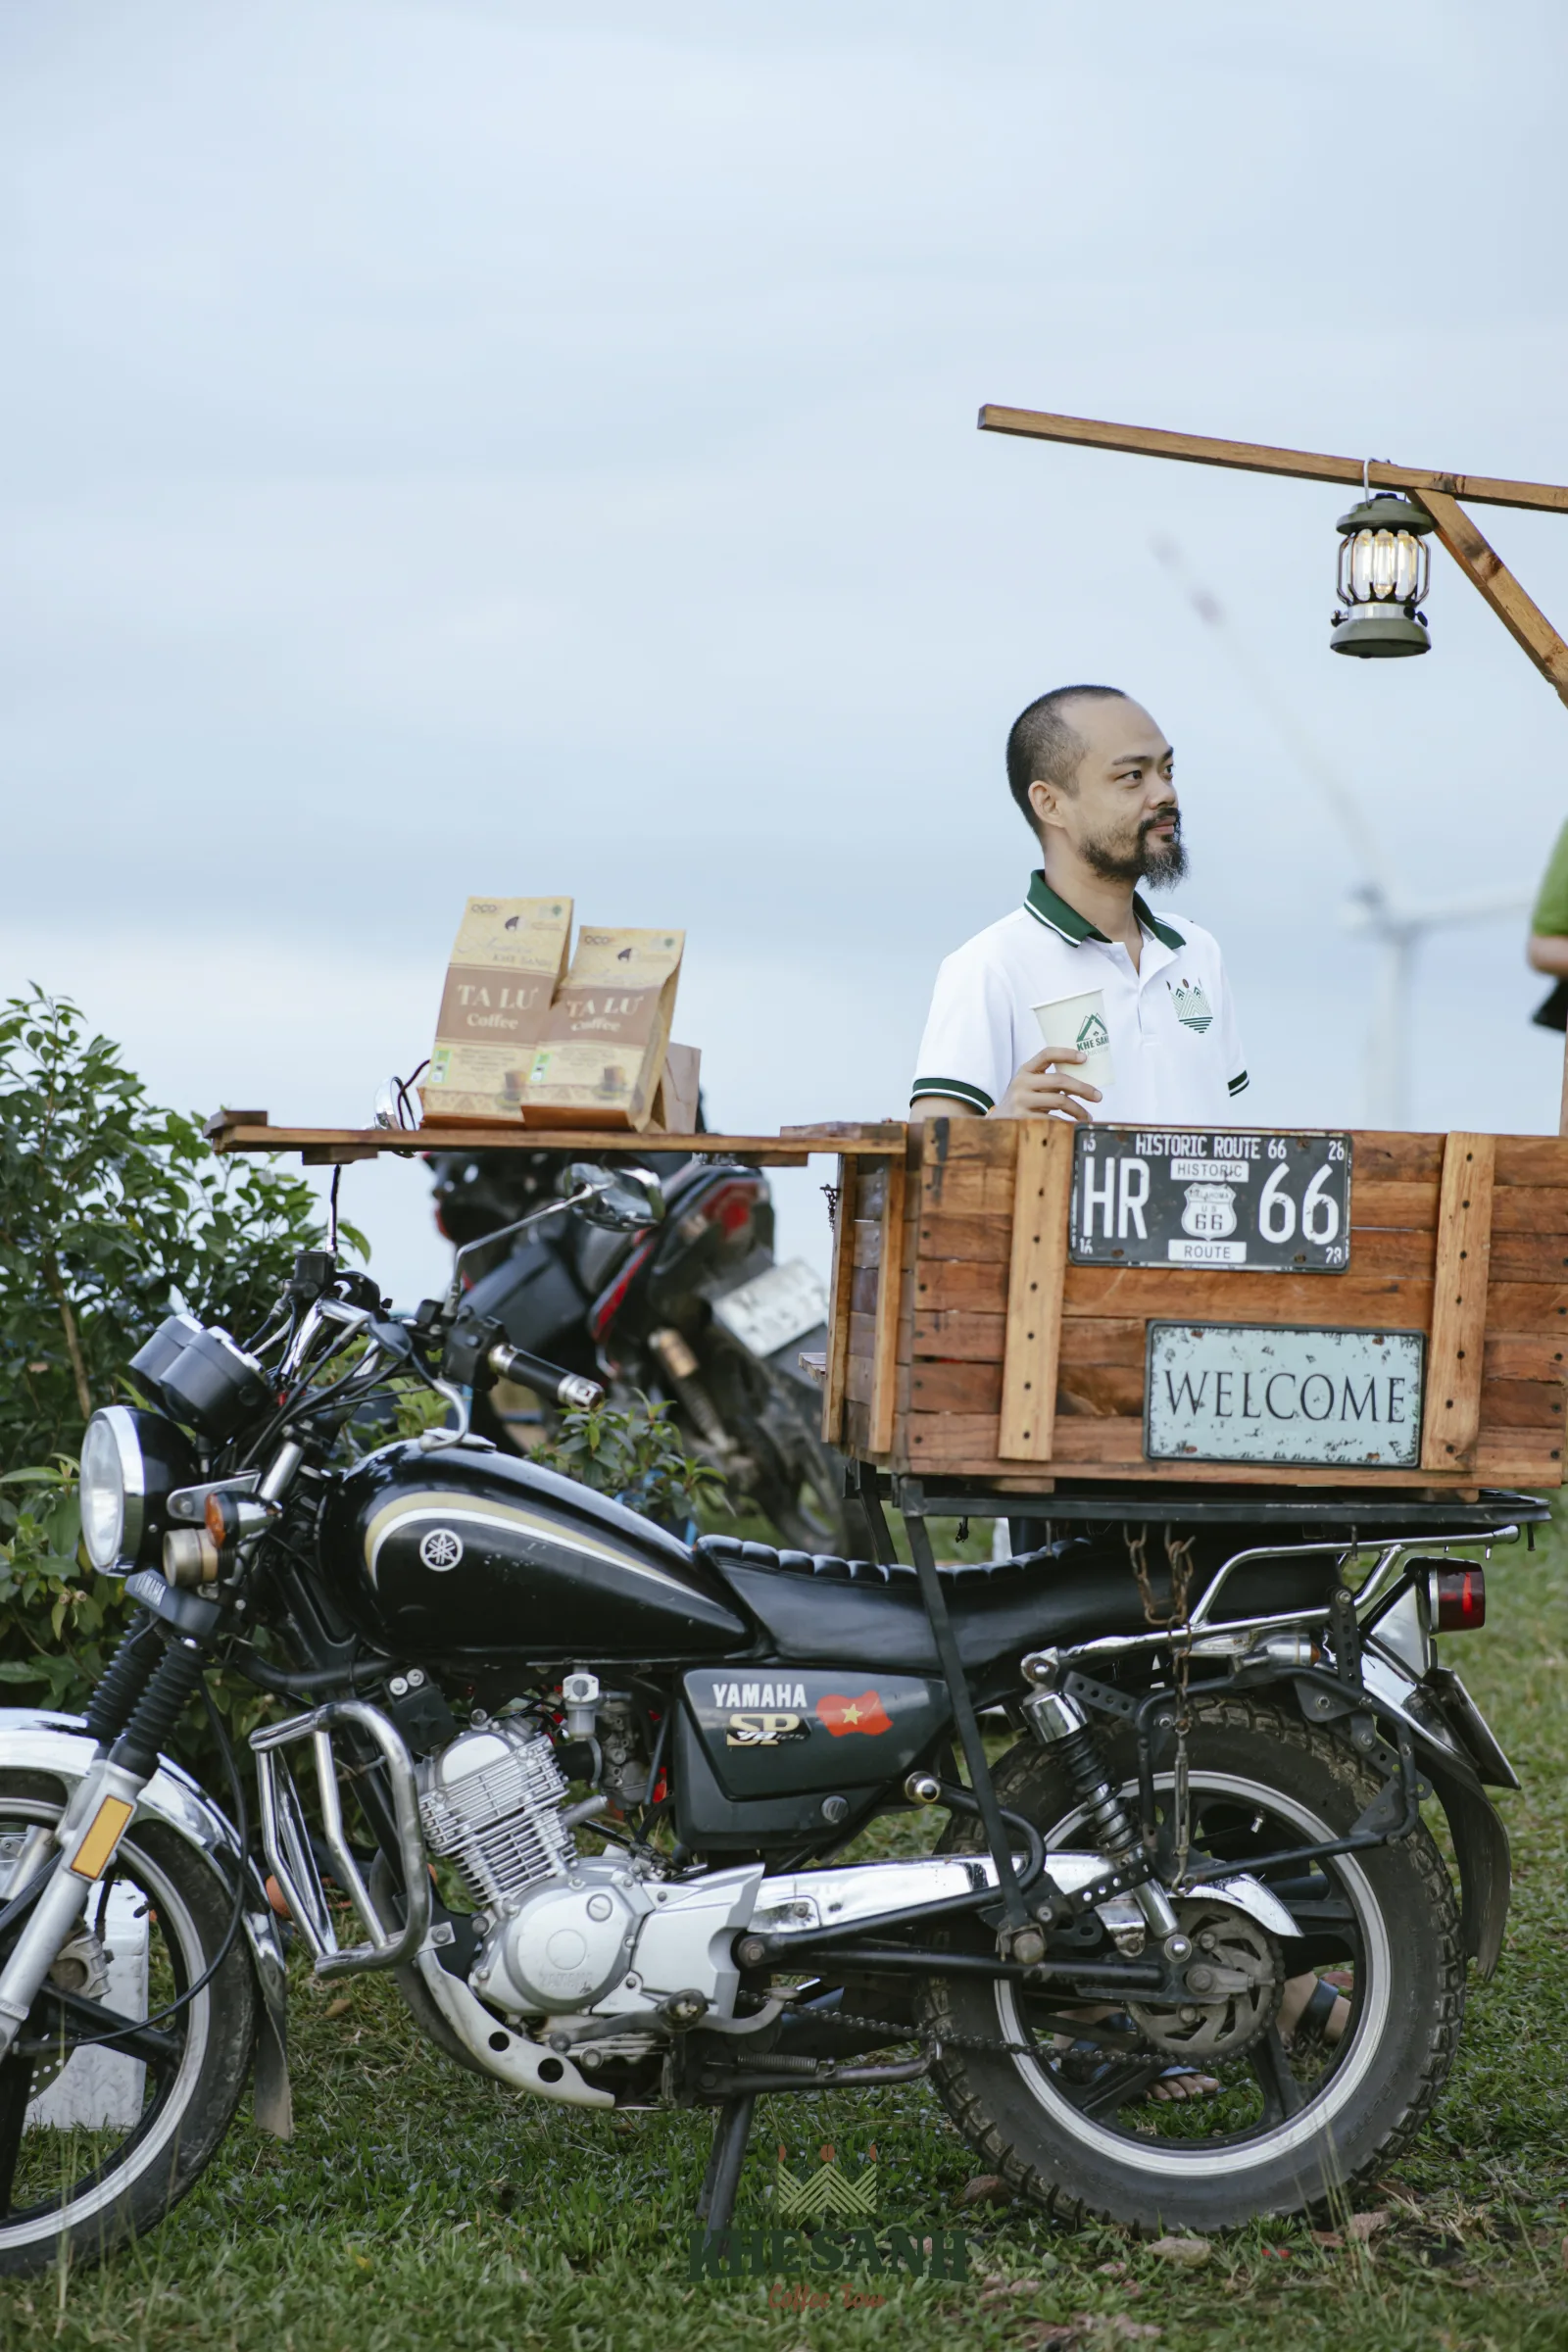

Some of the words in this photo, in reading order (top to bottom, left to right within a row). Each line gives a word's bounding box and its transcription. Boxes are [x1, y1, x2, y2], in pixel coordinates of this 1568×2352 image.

[457, 984, 491, 1007] TA
[566, 999, 596, 1018] TA
[466, 1012, 518, 1030] Coffee
[1076, 1039, 1095, 1052] KHE
[1136, 1133, 1207, 1158] HISTORIC
[1213, 1136, 1261, 1159] ROUTE
[1268, 1138, 1288, 1159] 66
[1177, 1163, 1243, 1178] HISTORIC
[1083, 1156, 1151, 1240] HR
[1258, 1162, 1340, 1245] 66
[1196, 1213, 1223, 1231] 66
[1184, 1245, 1232, 1259] ROUTE
[1163, 1370, 1405, 1423] WELCOME
[134, 1571, 167, 1607] YAMAHA
[711, 1683, 808, 1708] YAMAHA
[727, 1713, 800, 1746] SP
